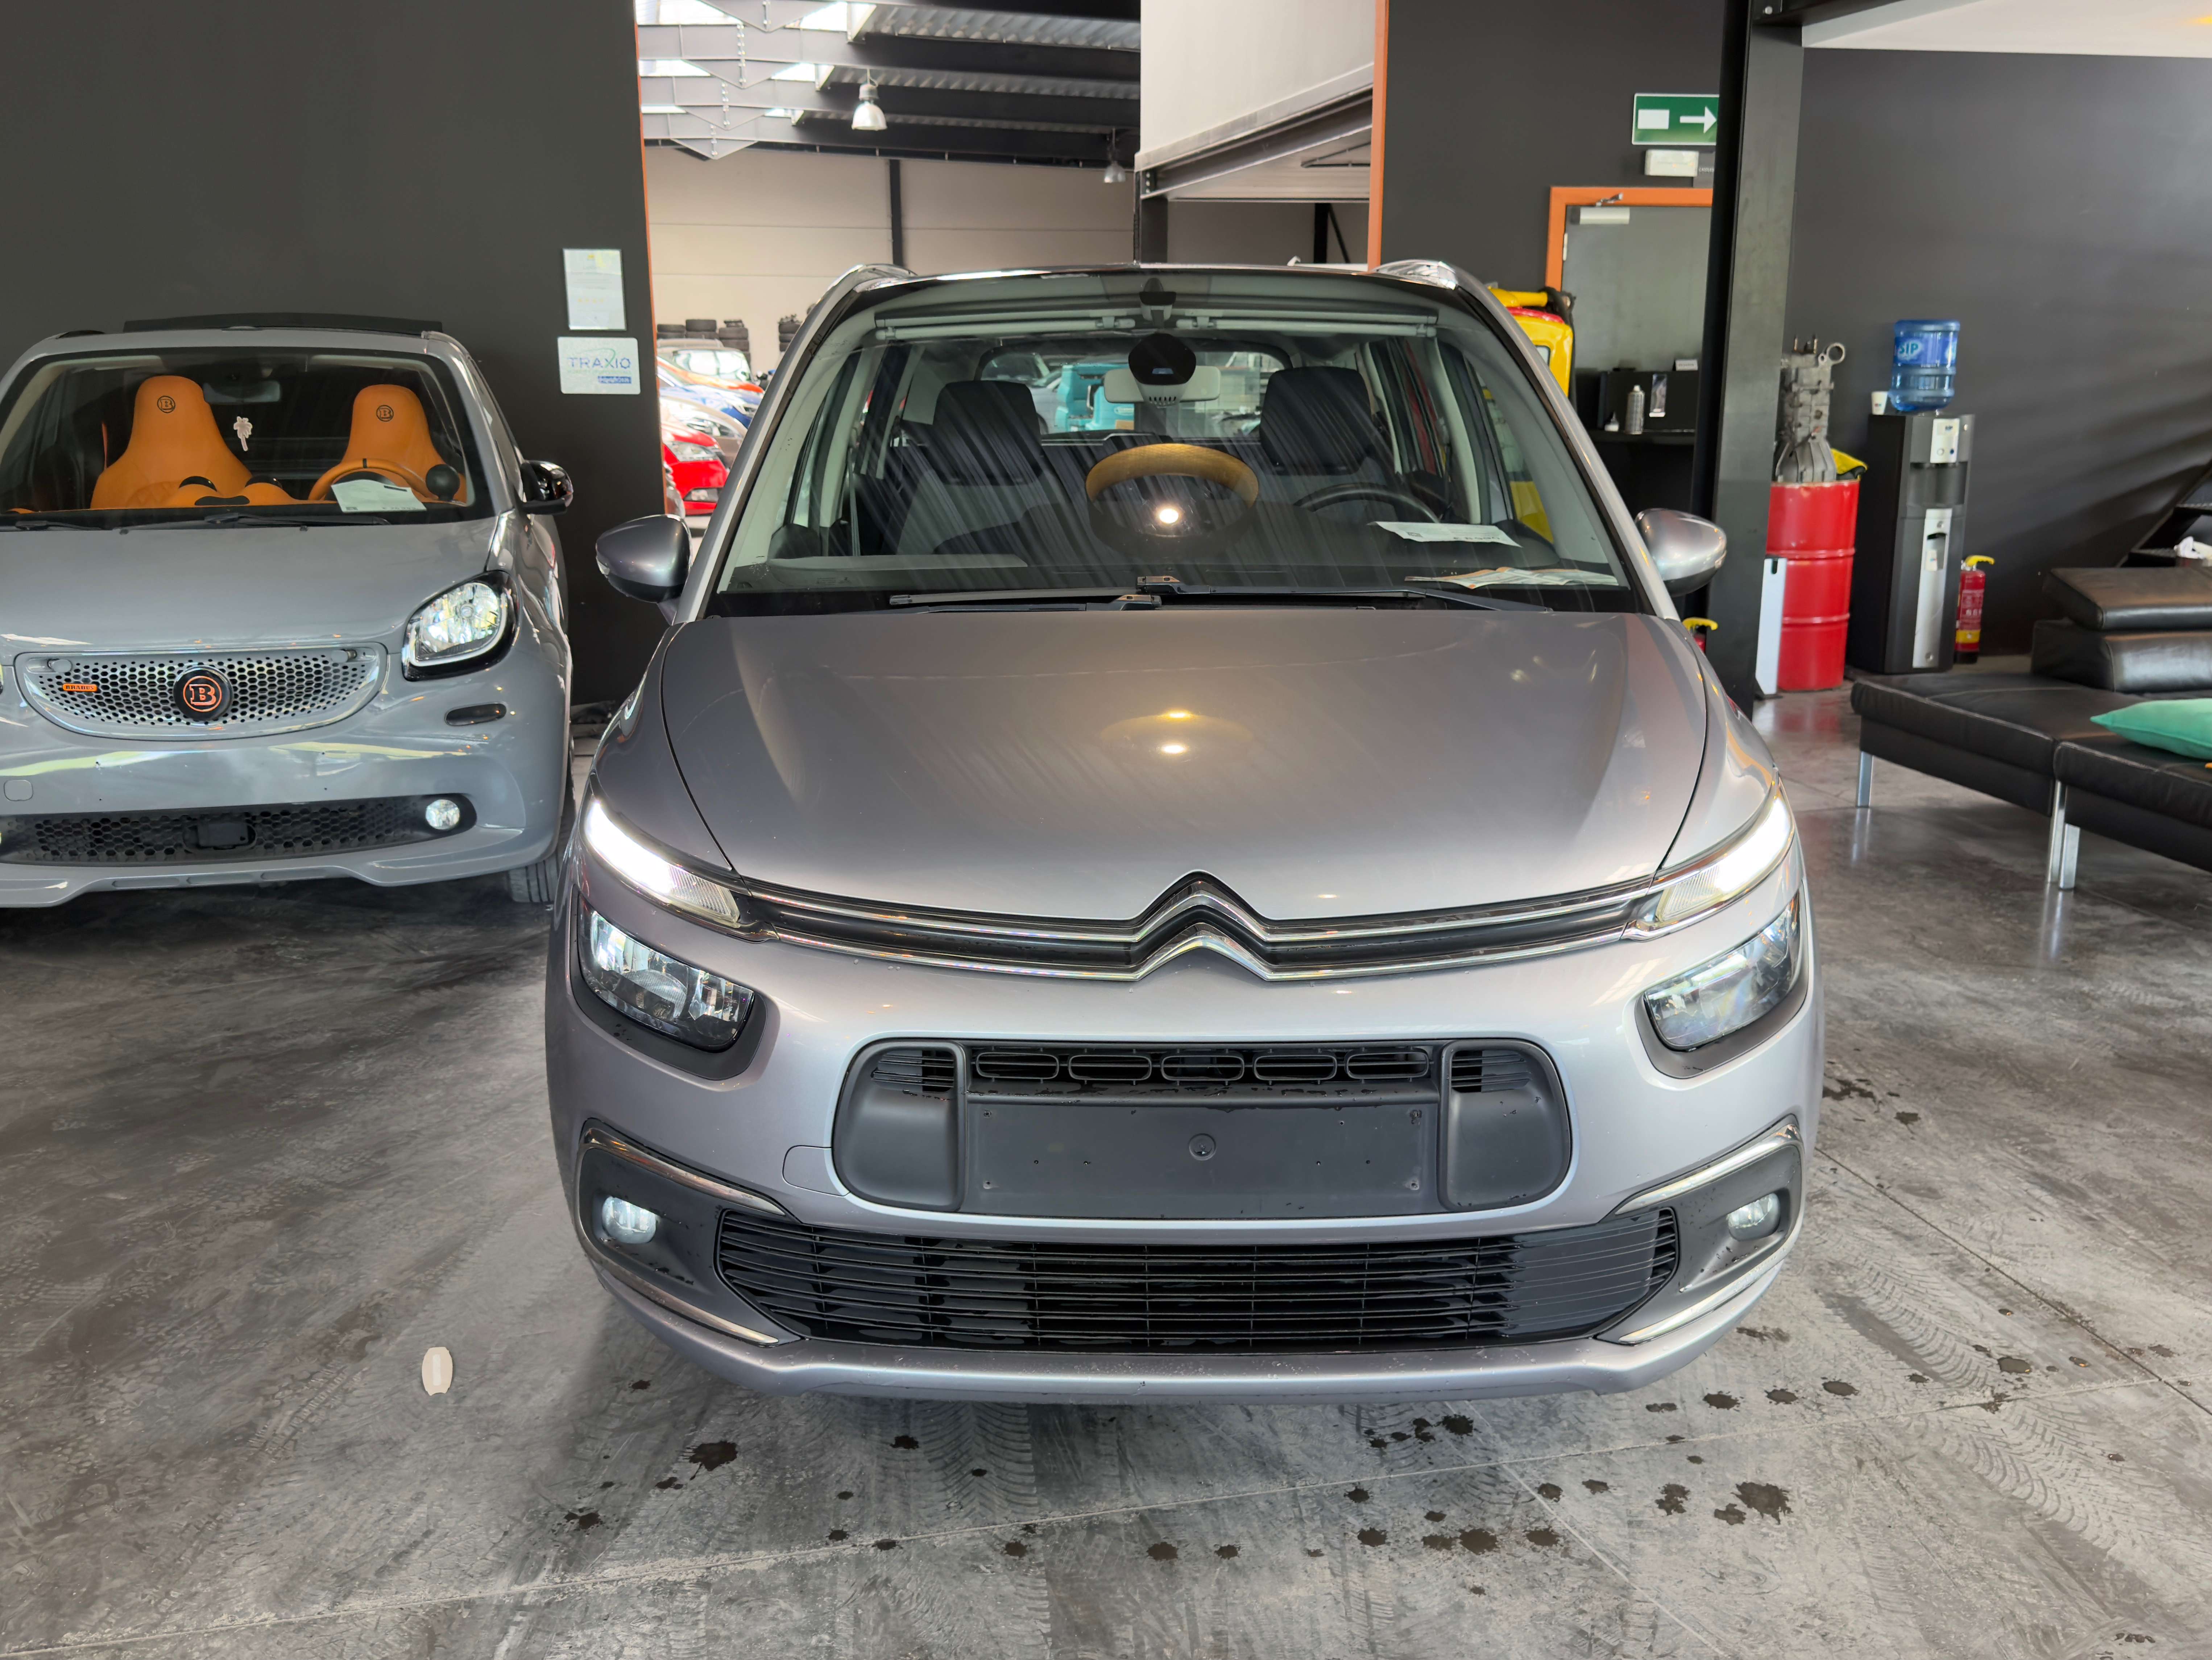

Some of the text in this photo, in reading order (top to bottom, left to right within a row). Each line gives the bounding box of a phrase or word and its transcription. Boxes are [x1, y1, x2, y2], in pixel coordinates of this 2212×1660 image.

[1899, 342, 1918, 354] SIP
[567, 357, 630, 369] TRAXIO
[189, 684, 216, 706] B
